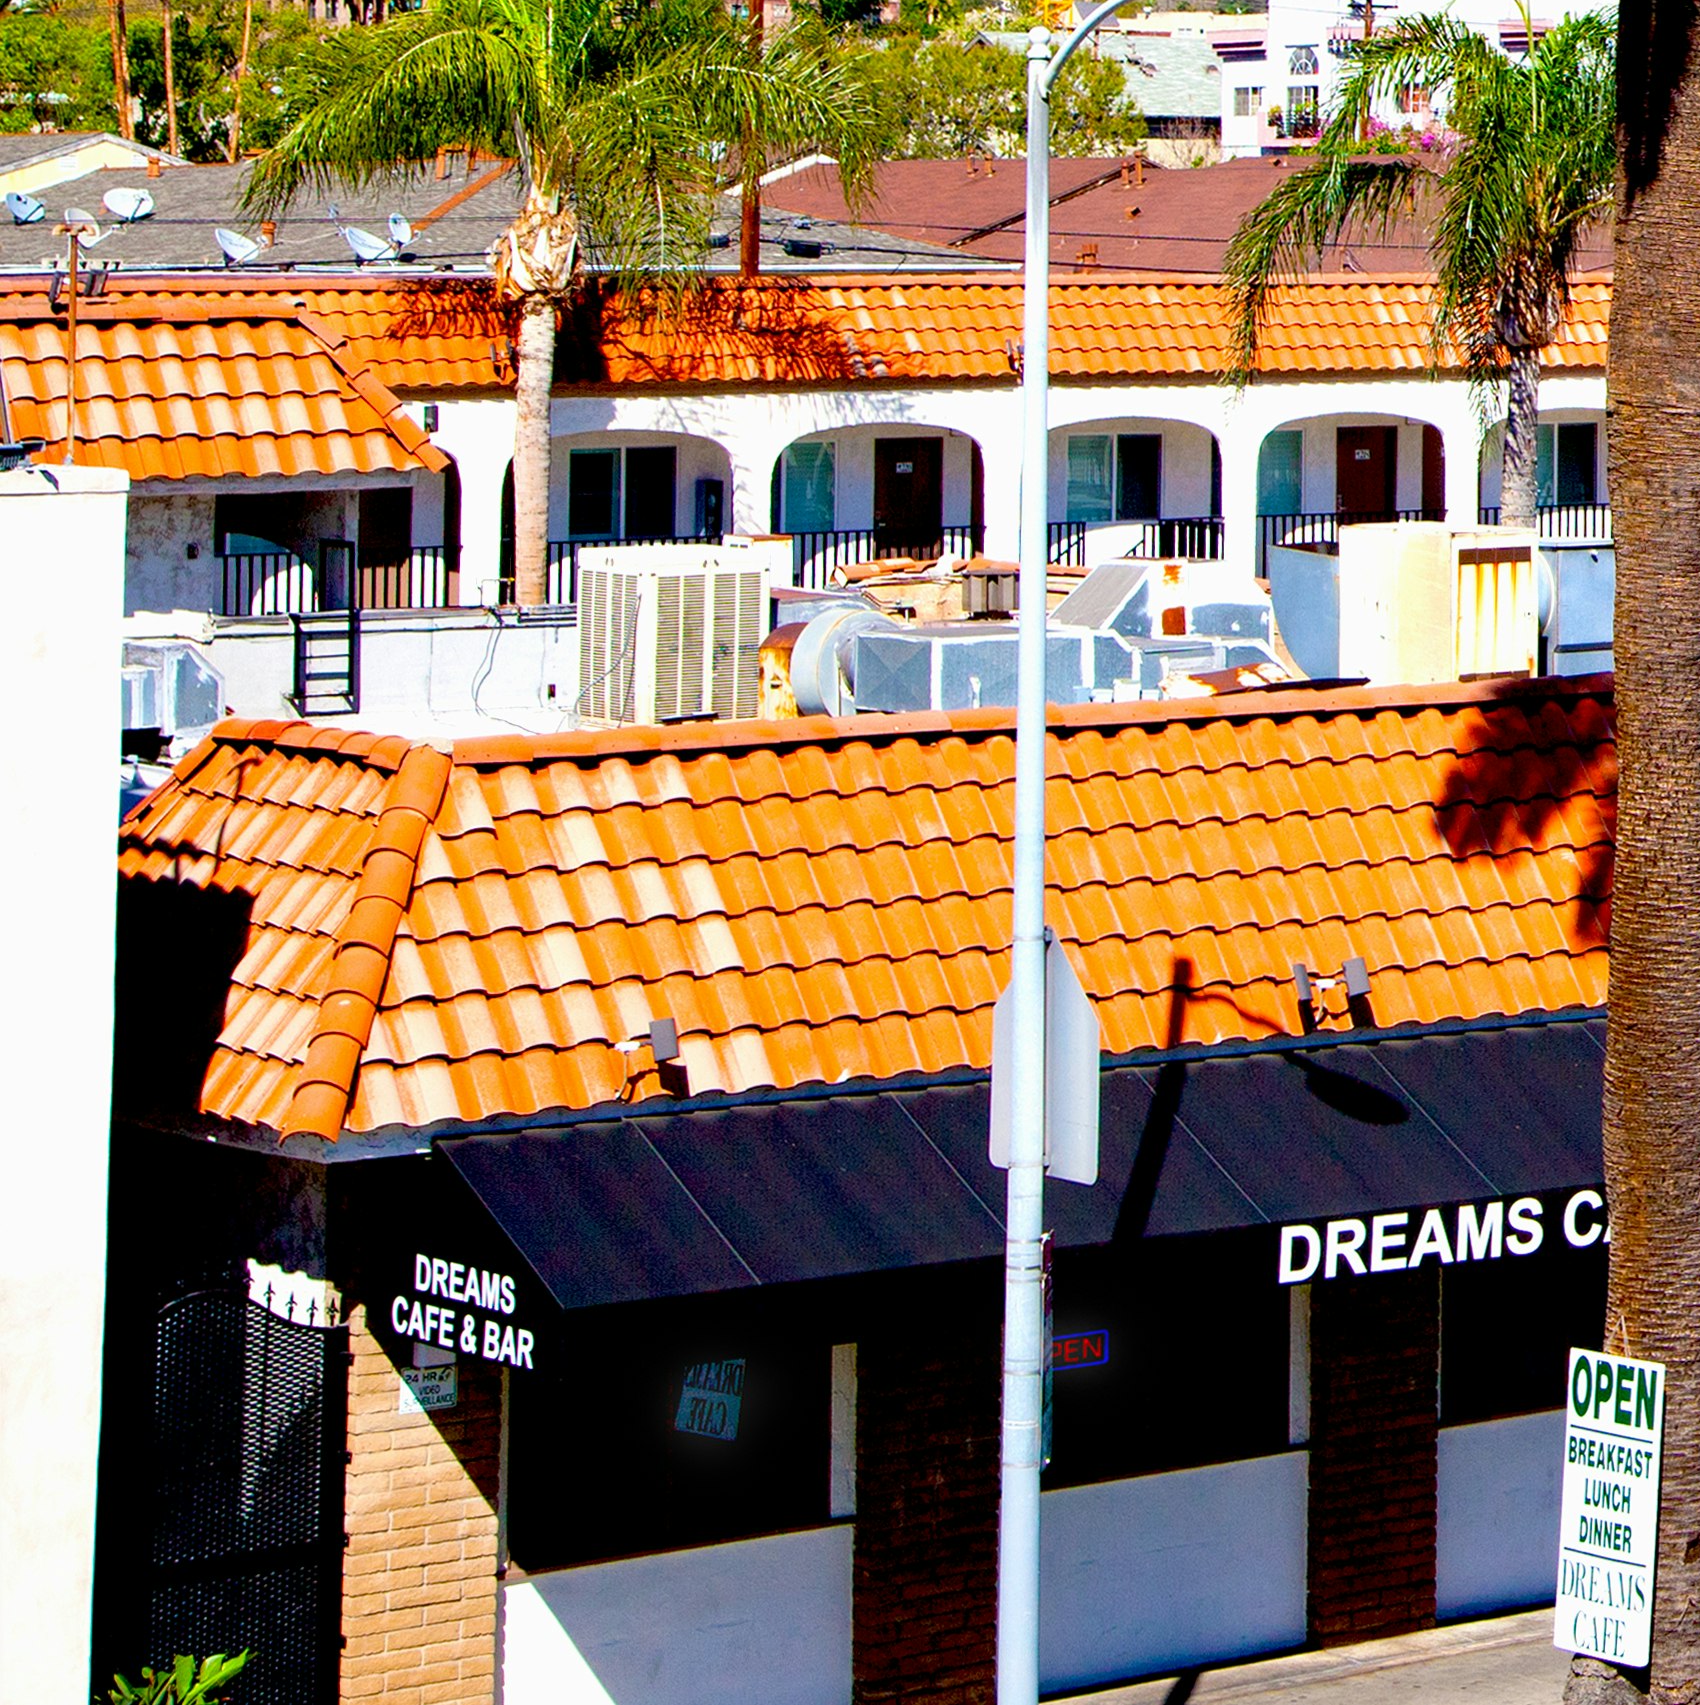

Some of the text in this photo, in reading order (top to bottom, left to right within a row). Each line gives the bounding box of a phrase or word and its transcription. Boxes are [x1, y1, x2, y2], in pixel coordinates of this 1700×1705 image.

[1278, 1197, 1544, 1284] DREAMS
[415, 1253, 516, 1314] DREAMS
[392, 1295, 534, 1370] CAFE & BAR
[1052, 1337, 1101, 1363] PEN
[419, 1385, 440, 1395] VIDEO
[423, 1372, 437, 1383] HR
[1572, 1354, 1657, 1430] OPEN
[1568, 1436, 1653, 1479] BREAKFAST
[1584, 1478, 1631, 1514] LUNCH
[1579, 1516, 1631, 1553] DINNER
[1562, 1559, 1646, 1613] DREAMS
[1573, 1610, 1626, 1658] CAFE
